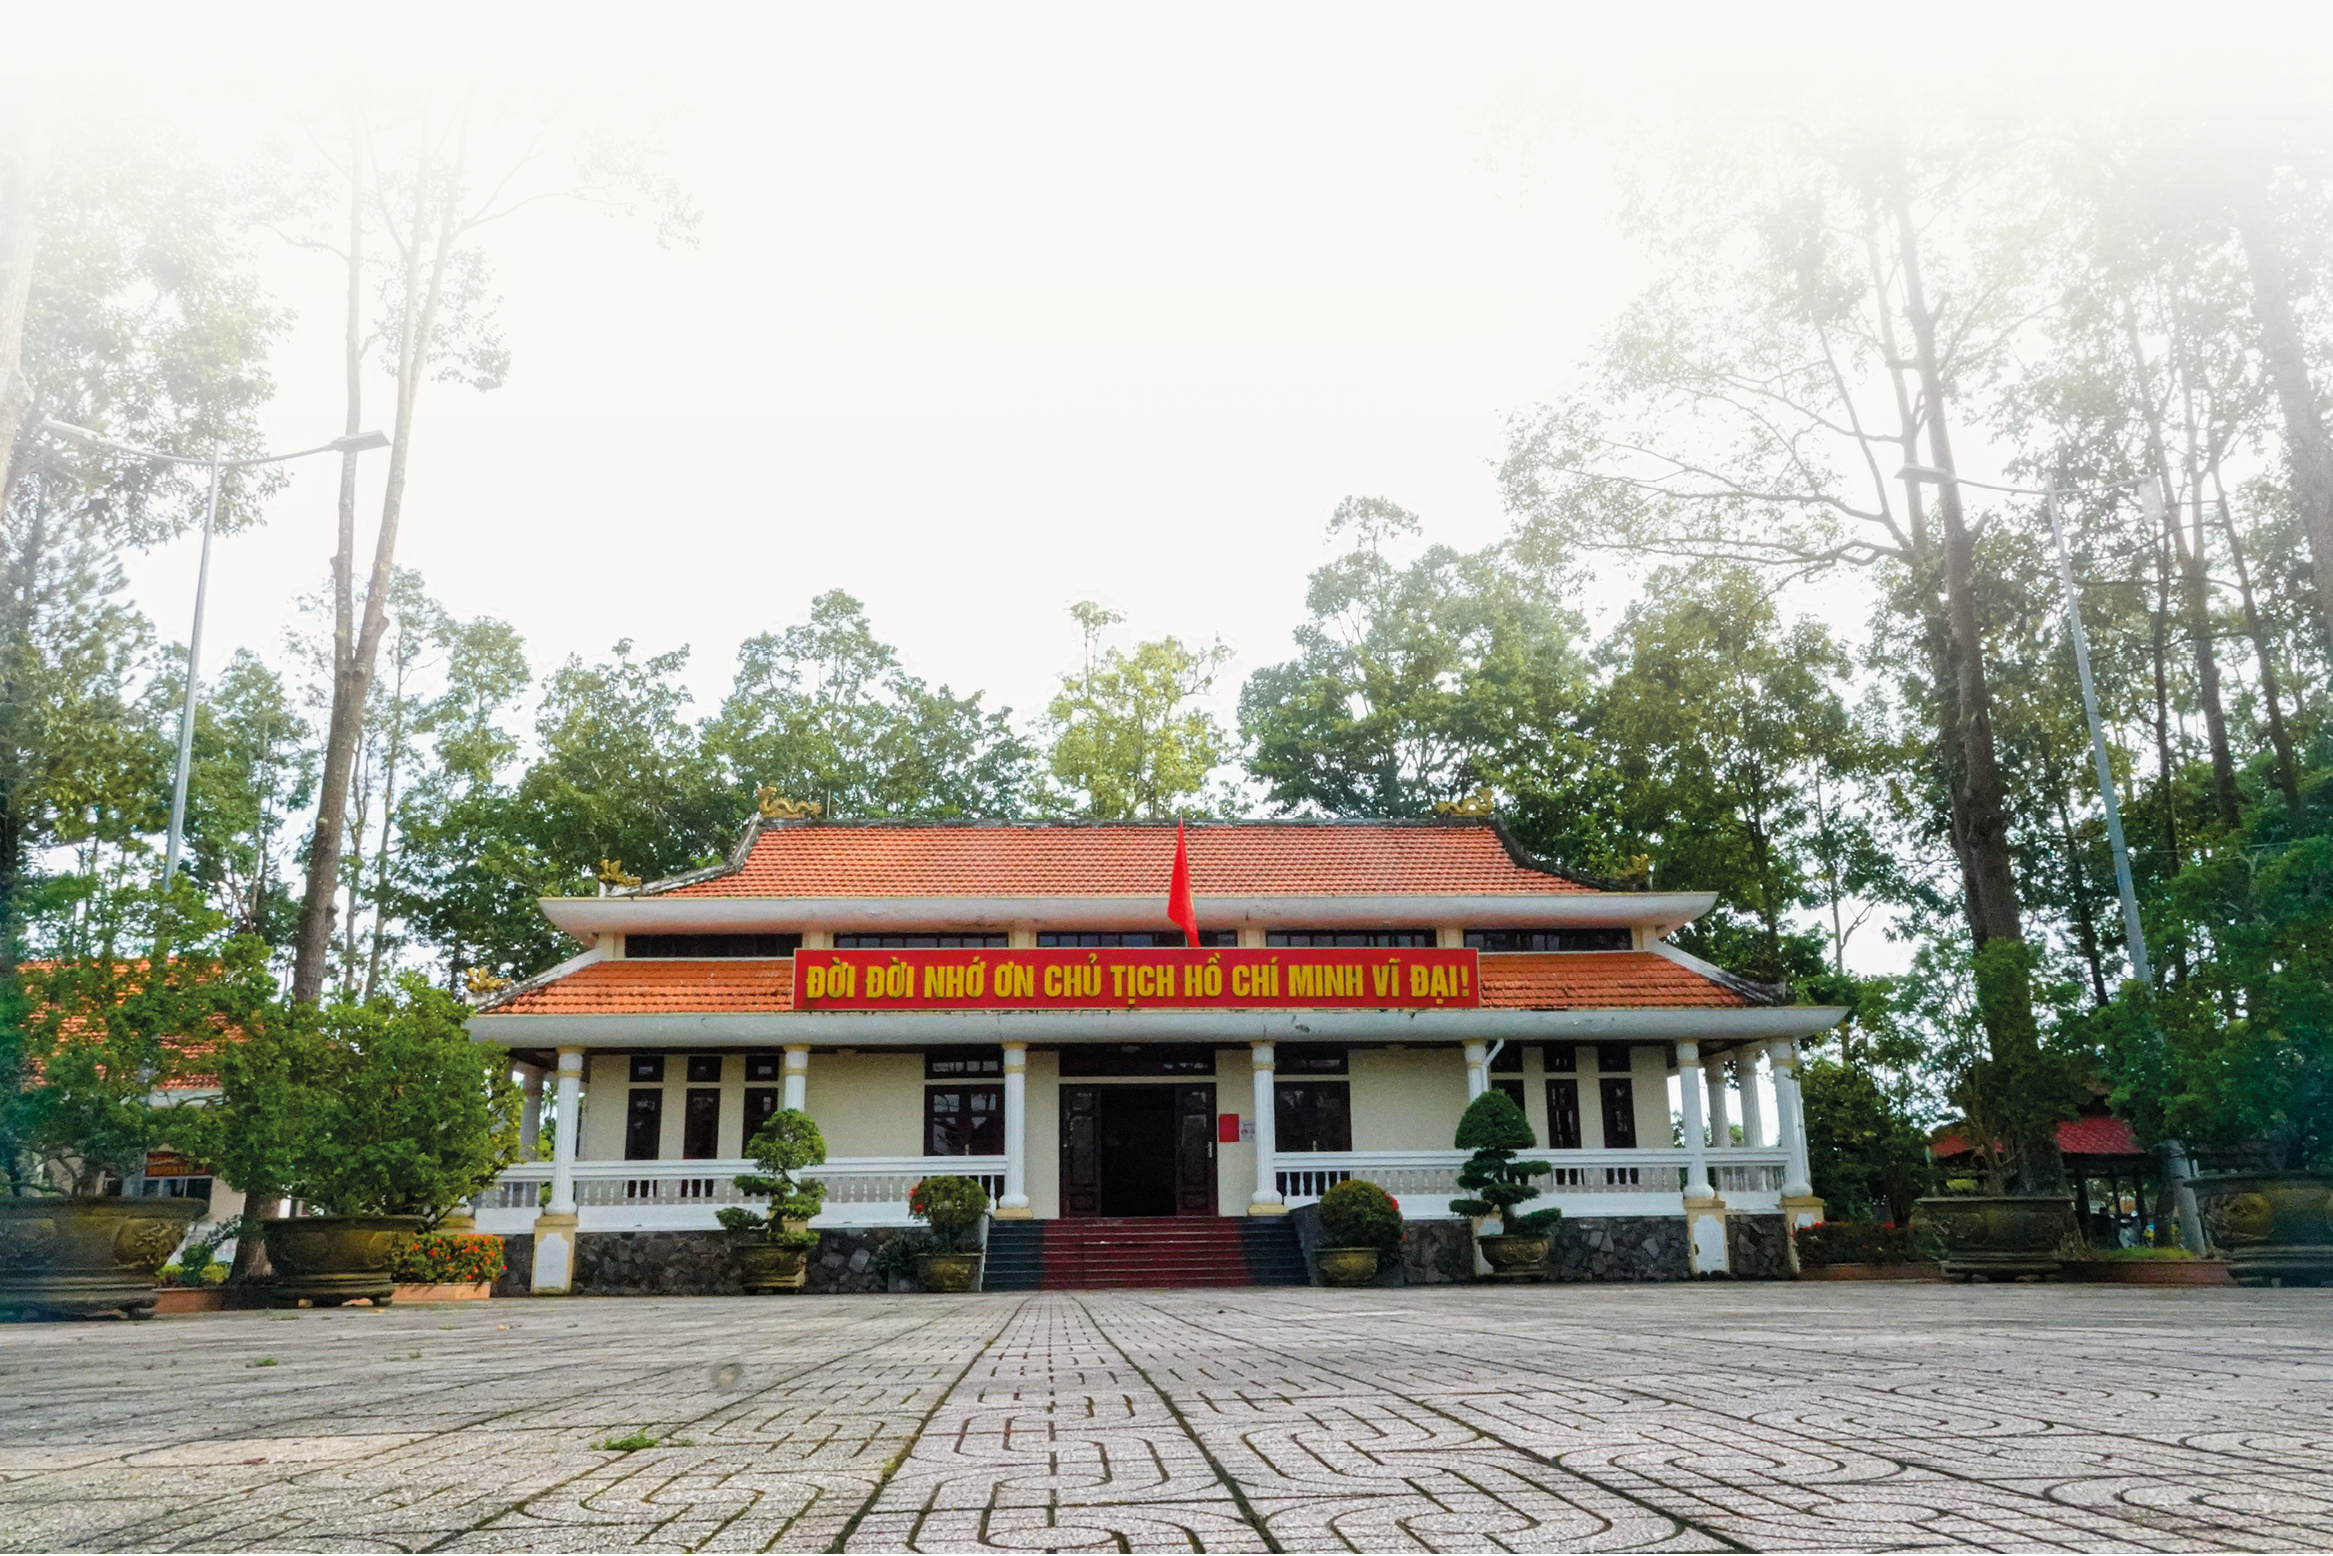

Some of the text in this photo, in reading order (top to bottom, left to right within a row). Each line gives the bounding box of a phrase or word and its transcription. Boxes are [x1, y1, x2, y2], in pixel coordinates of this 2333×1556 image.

[806, 952, 1469, 1005] ĐỜI ĐỜI NHỚ ƠN CHỦ TỊCH HỒ CHÍ MINH VĨ ĐẠI!
